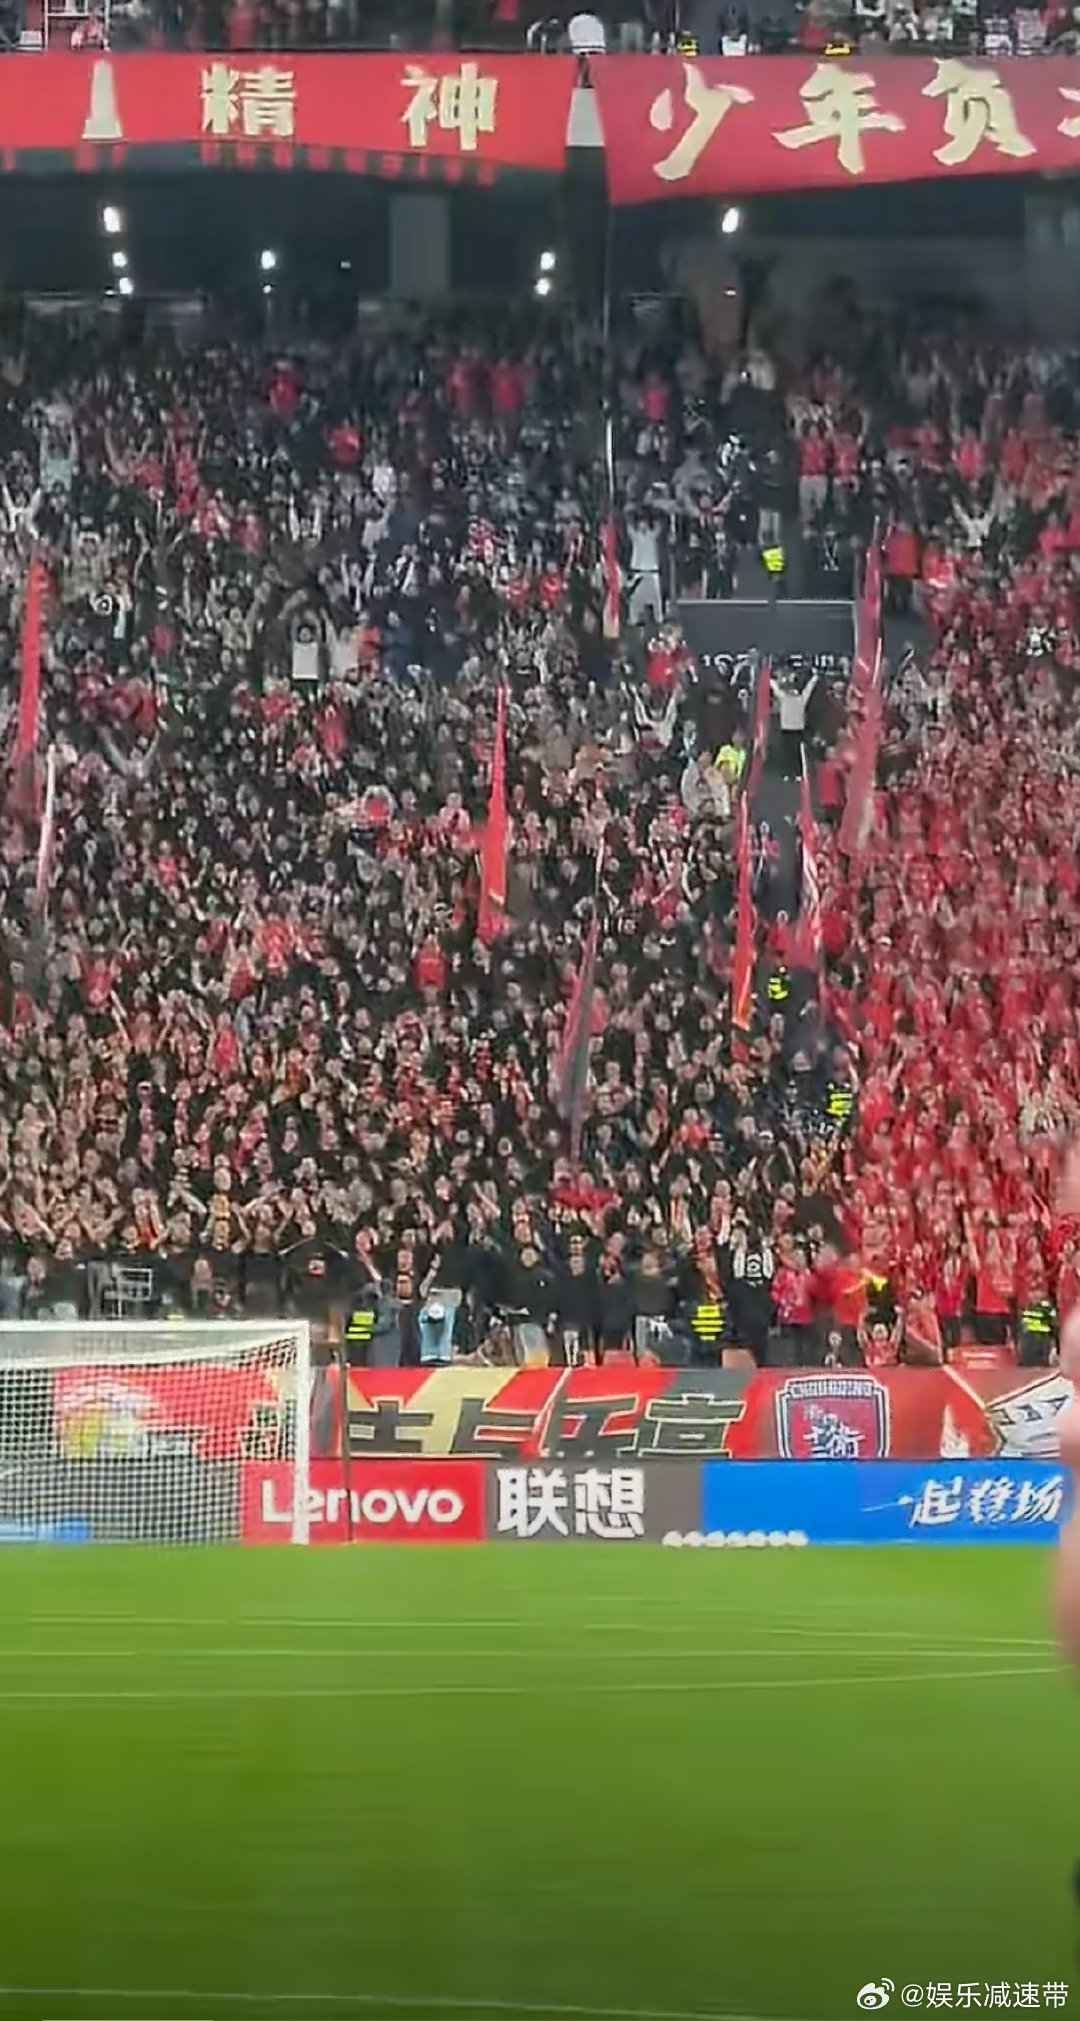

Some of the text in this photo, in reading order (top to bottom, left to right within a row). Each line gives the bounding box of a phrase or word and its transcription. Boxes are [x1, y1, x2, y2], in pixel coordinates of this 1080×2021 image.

[200, 62, 498, 150] 精神
[650, 58, 1080, 181] 少年负
[496, 1467, 645, 1538] 联想
[861, 1476, 1063, 1529] 一起登场
